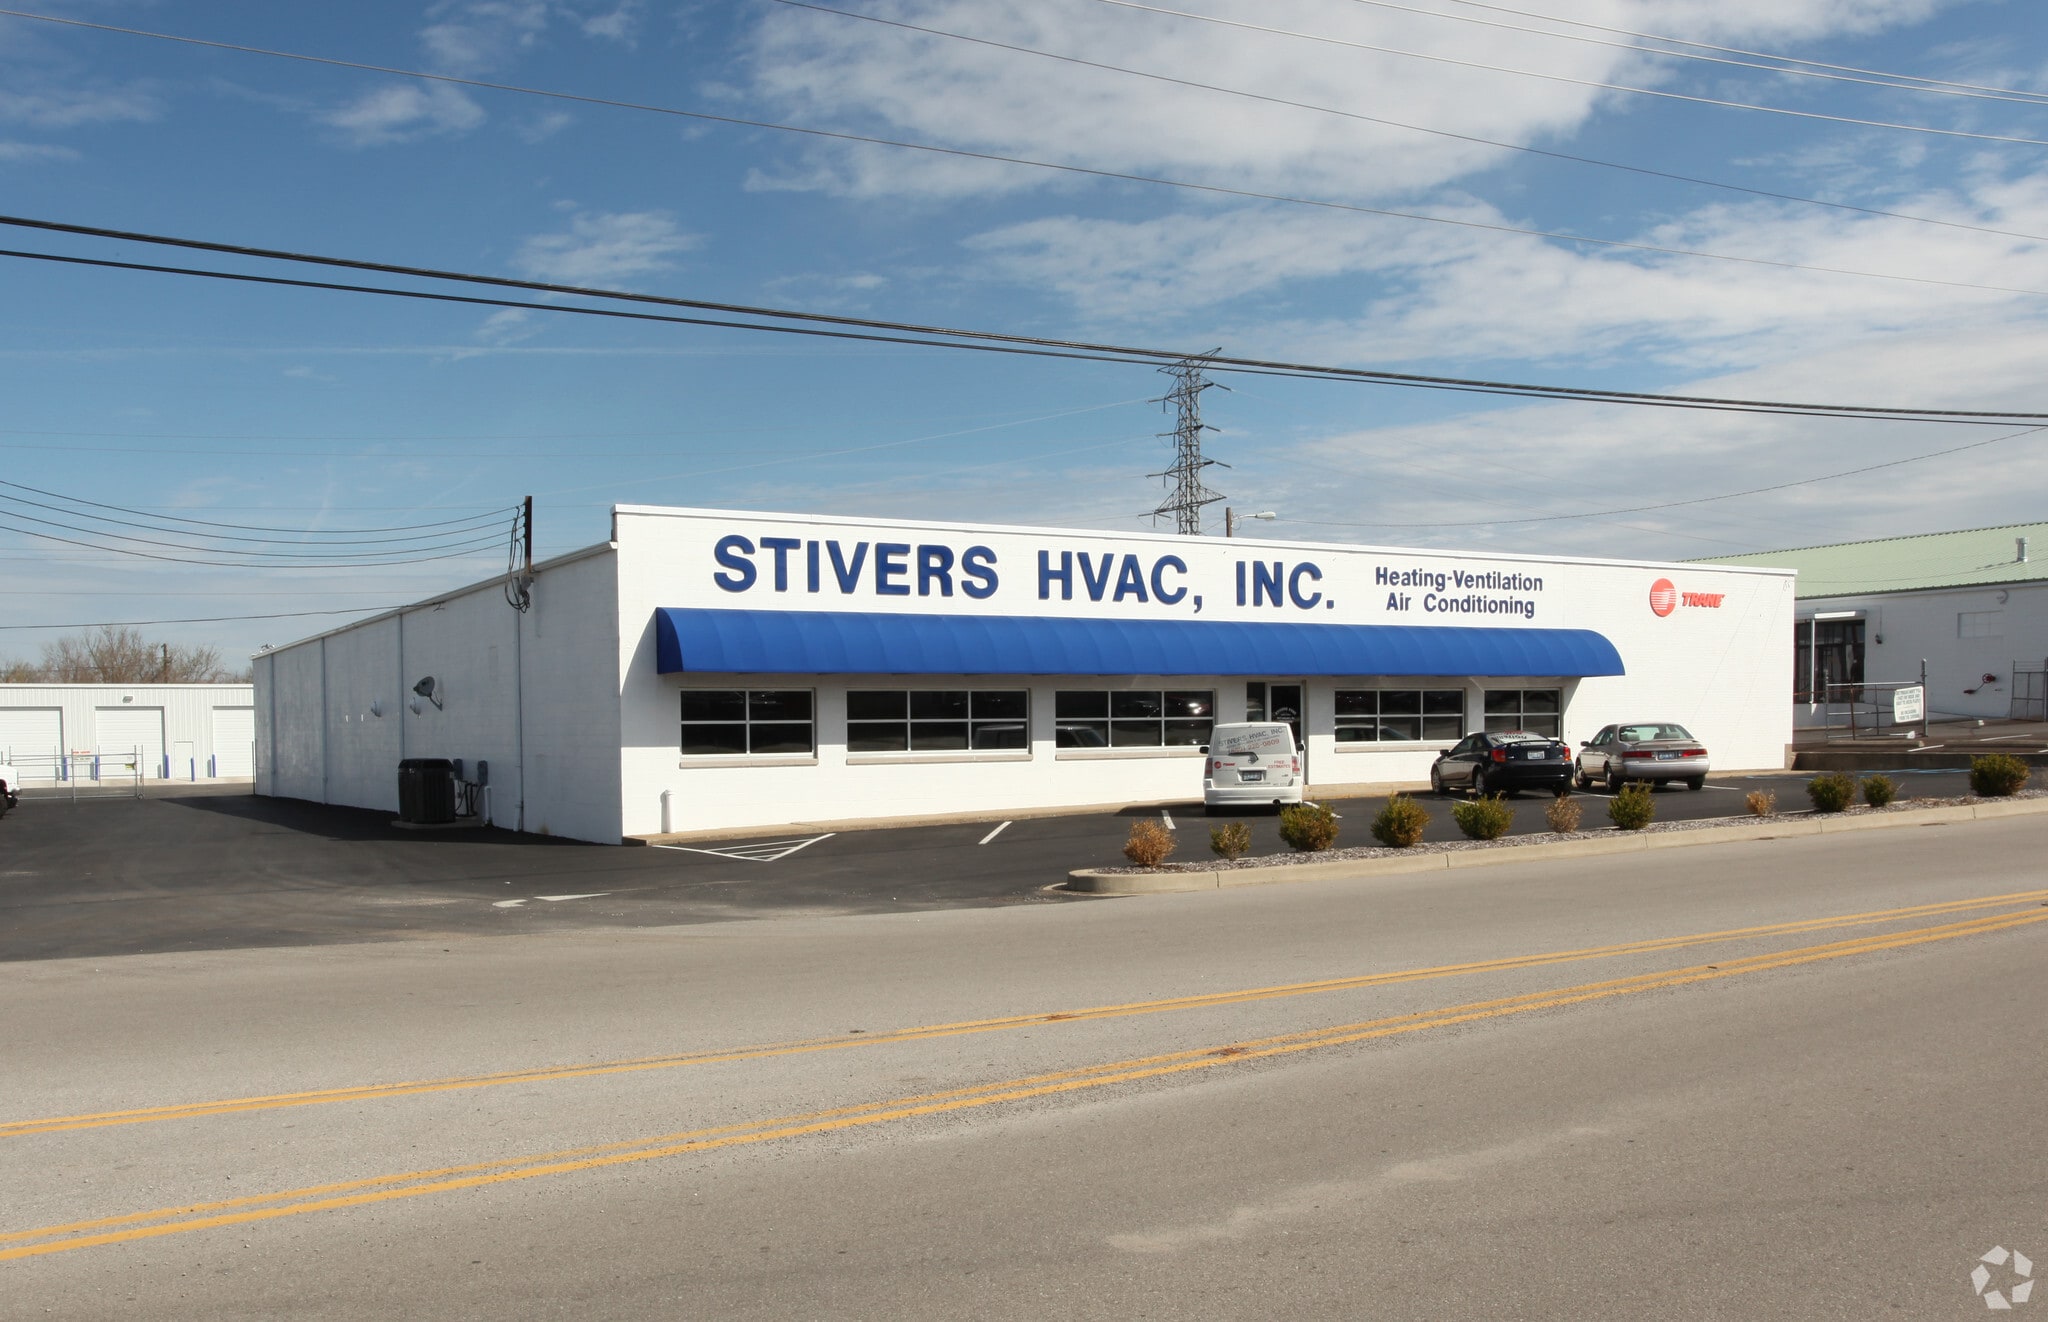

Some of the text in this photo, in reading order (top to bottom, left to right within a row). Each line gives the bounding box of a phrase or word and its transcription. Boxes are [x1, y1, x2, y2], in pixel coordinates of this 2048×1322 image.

[714, 535, 1335, 613] STIVERS HVAC, INC.
[1375, 566, 1543, 592] Heating-Ventilation
[1386, 592, 1535, 619] Air Conditioning
[1682, 592, 1724, 608] TRANE
